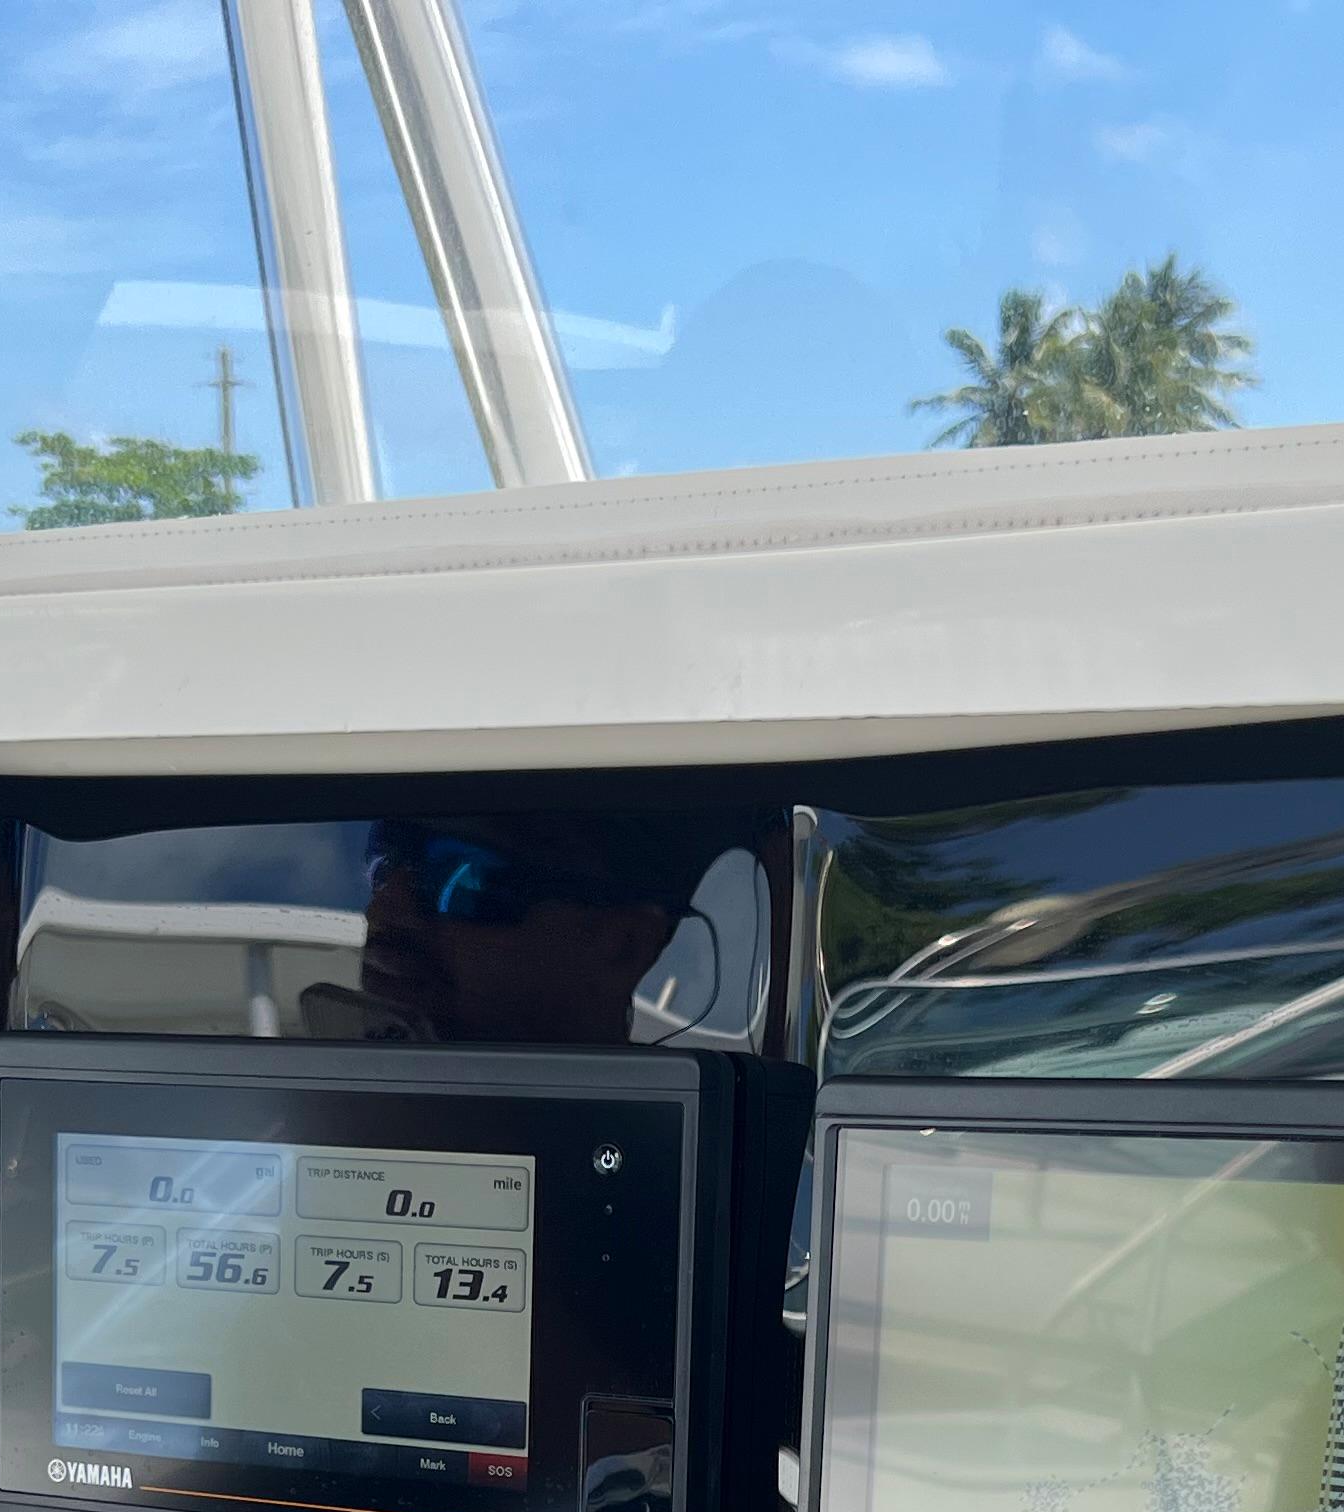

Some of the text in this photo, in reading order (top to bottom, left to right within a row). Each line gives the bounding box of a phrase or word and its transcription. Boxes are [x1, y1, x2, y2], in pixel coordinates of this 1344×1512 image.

[256, 1167, 274, 1179] gal
[307, 1168, 385, 1181] TRIP DISTANCE
[493, 1176, 522, 1191] mile
[149, 1175, 194, 1204] 0.0
[385, 1189, 435, 1218] 0.0
[907, 1198, 955, 1223] 0.00
[80, 1232, 101, 1242] TRIP
[105, 1233, 138, 1245] HOURS
[188, 1239, 218, 1251] TOTAL
[220, 1241, 256, 1253] HOURS
[92, 1244, 140, 1276] 7.5
[311, 1247, 390, 1263] TRIP HOURS (S)
[425, 1254, 518, 1271] TOTAL HOURS (S)
[187, 1251, 268, 1285] 56.6
[322, 1260, 374, 1293] 7.5
[433, 1268, 508, 1303] 13.4
[116, 1383, 157, 1397] Reset All
[430, 1412, 457, 1425] Back
[129, 1430, 161, 1444] Engine
[201, 1436, 219, 1449] Info
[268, 1442, 304, 1457] Home
[420, 1458, 446, 1471] Mark
[488, 1465, 512, 1477] SOS
[66, 1461, 132, 1489] YAMAHA
